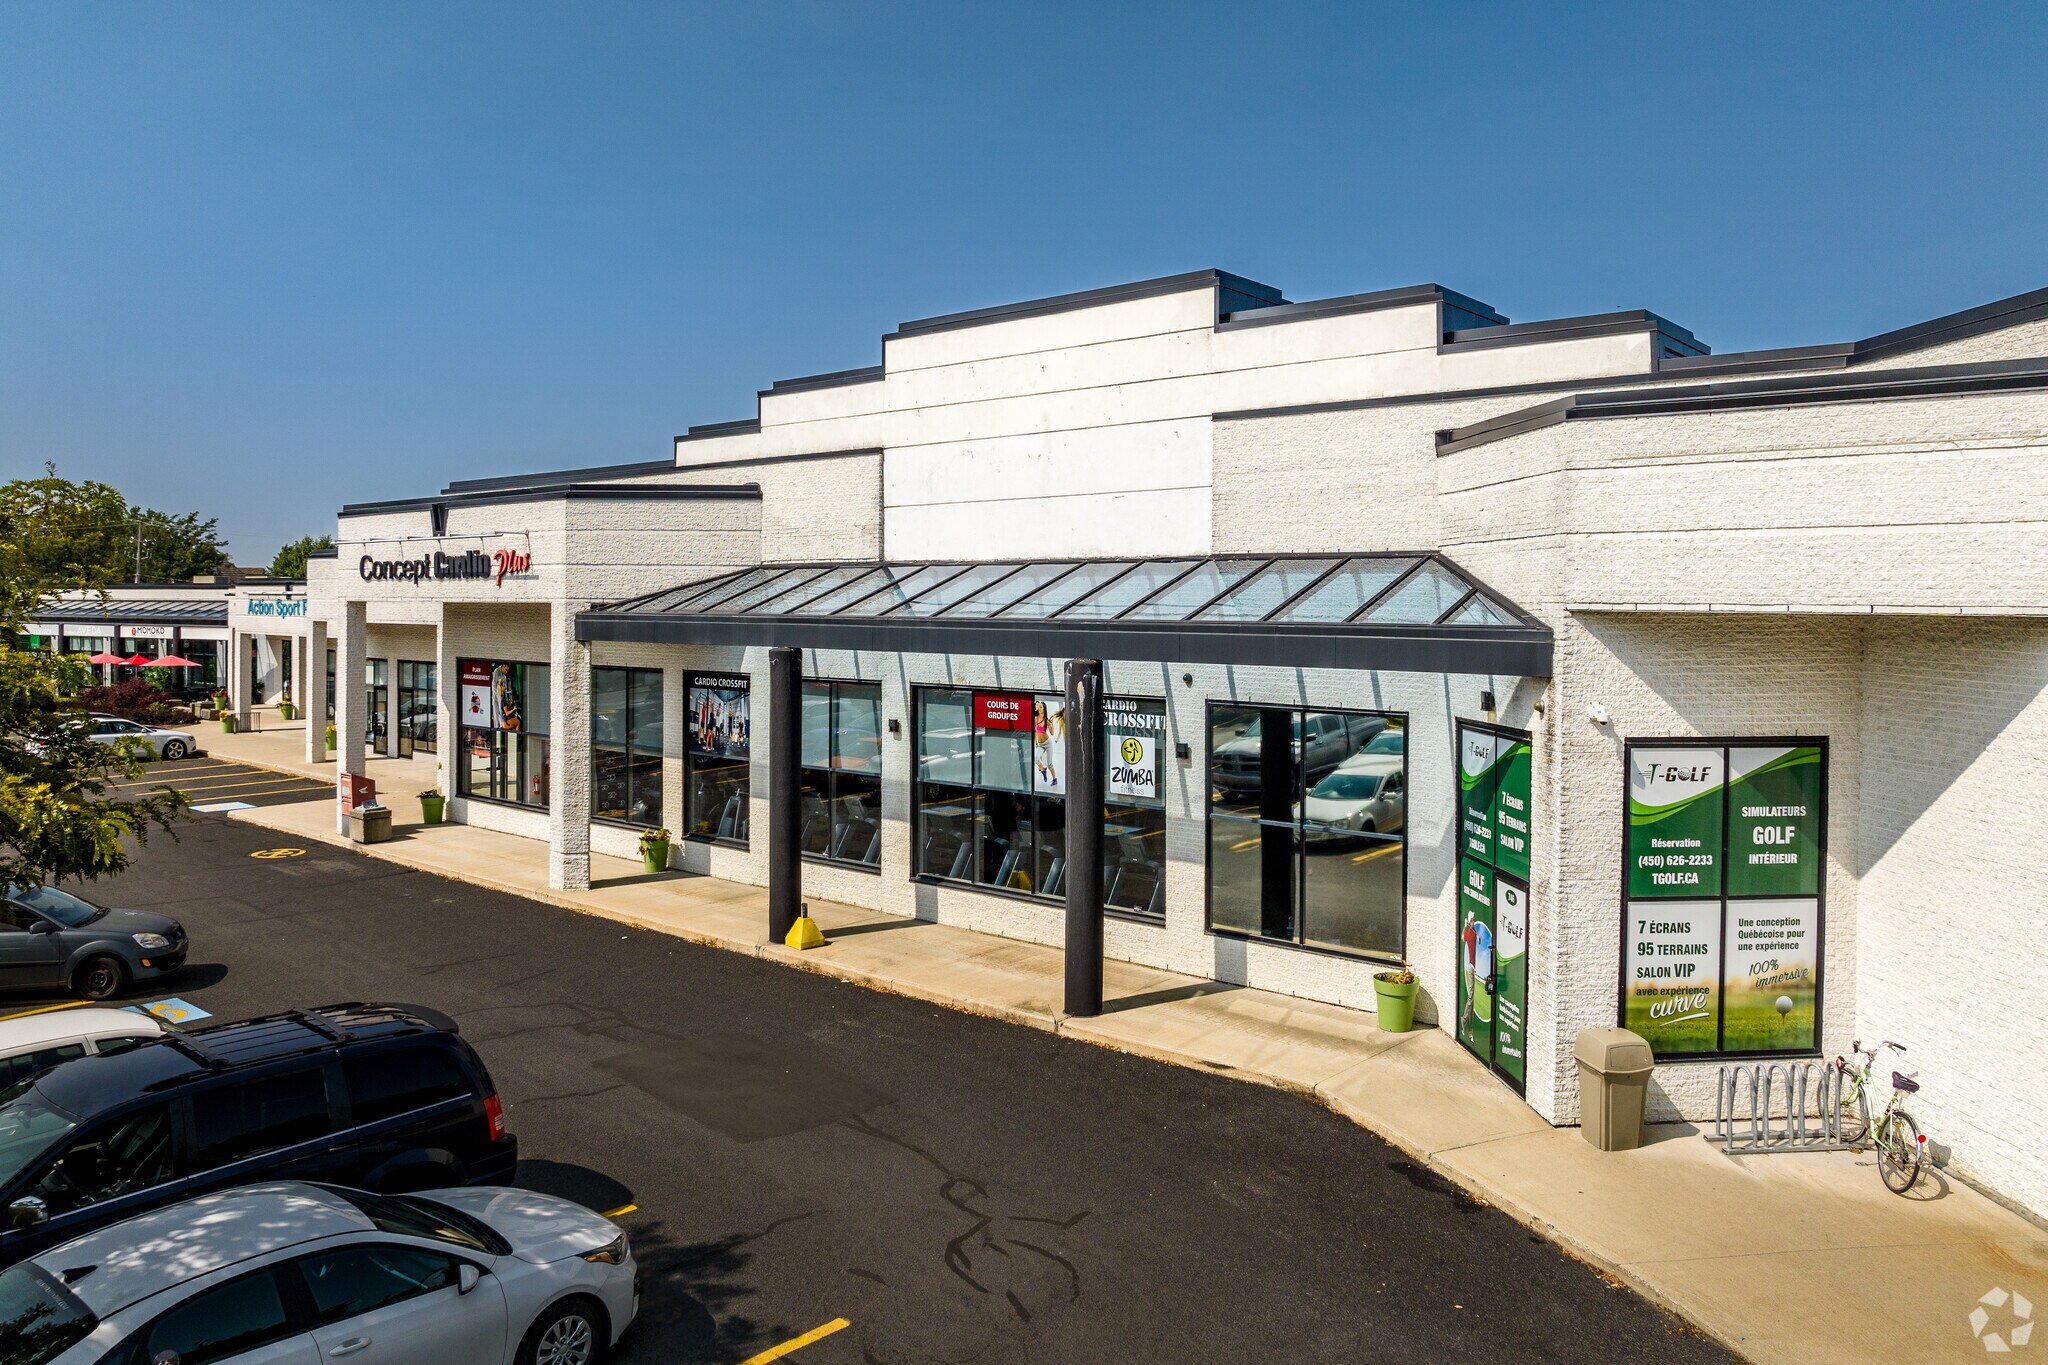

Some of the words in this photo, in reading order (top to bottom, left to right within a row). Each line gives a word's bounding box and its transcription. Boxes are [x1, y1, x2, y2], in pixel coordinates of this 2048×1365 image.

[359, 554, 431, 585] Concept
[493, 549, 530, 587] Plus
[248, 599, 275, 615] Action
[276, 599, 300, 619] Sport
[77, 626, 101, 636] AVEDA
[136, 626, 165, 635] MOMOKO
[694, 677, 717, 686] CARDIO
[718, 679, 748, 688] CROSSFIT
[987, 700, 1009, 710] COURS
[1010, 702, 1019, 710] DE
[1103, 700, 1137, 712] ARDIO
[987, 711, 1018, 721] GROUPES
[1111, 766, 1154, 787] ZUMBA
[1649, 763, 1711, 785] T-GOLF
[1121, 785, 1145, 795] fitness
[1741, 806, 1807, 818] SIMULATEURS
[1752, 826, 1796, 846] GOLF
[1651, 838, 1701, 849] Réservation
[1638, 855, 1665, 869] (450)
[1666, 854, 1713, 867] 626-2233
[1748, 851, 1798, 865] INTÉRIEUR
[1469, 869, 1485, 891] GOLF
[1652, 872, 1699, 885] TGOLF.CA
[1638, 921, 1647, 934] 7
[1649, 920, 1691, 934] ÉCRANS
[1738, 918, 1754, 927] Une
[1756, 917, 1801, 928] conception
[1738, 930, 1784, 939] Québécoise
[1786, 931, 1806, 940] pour
[1637, 942, 1654, 956] 95
[1657, 943, 1709, 956] TERRAINS
[1755, 941, 1800, 953] expérience
[1637, 967, 1671, 978] SALON
[1674, 963, 1696, 977] VIP
[1749, 959, 1779, 976] 100%
[1755, 968, 1809, 988] immersive
[1636, 988, 1658, 996] avec
[1660, 986, 1710, 998] expérience
[1650, 993, 1707, 1019] curve
